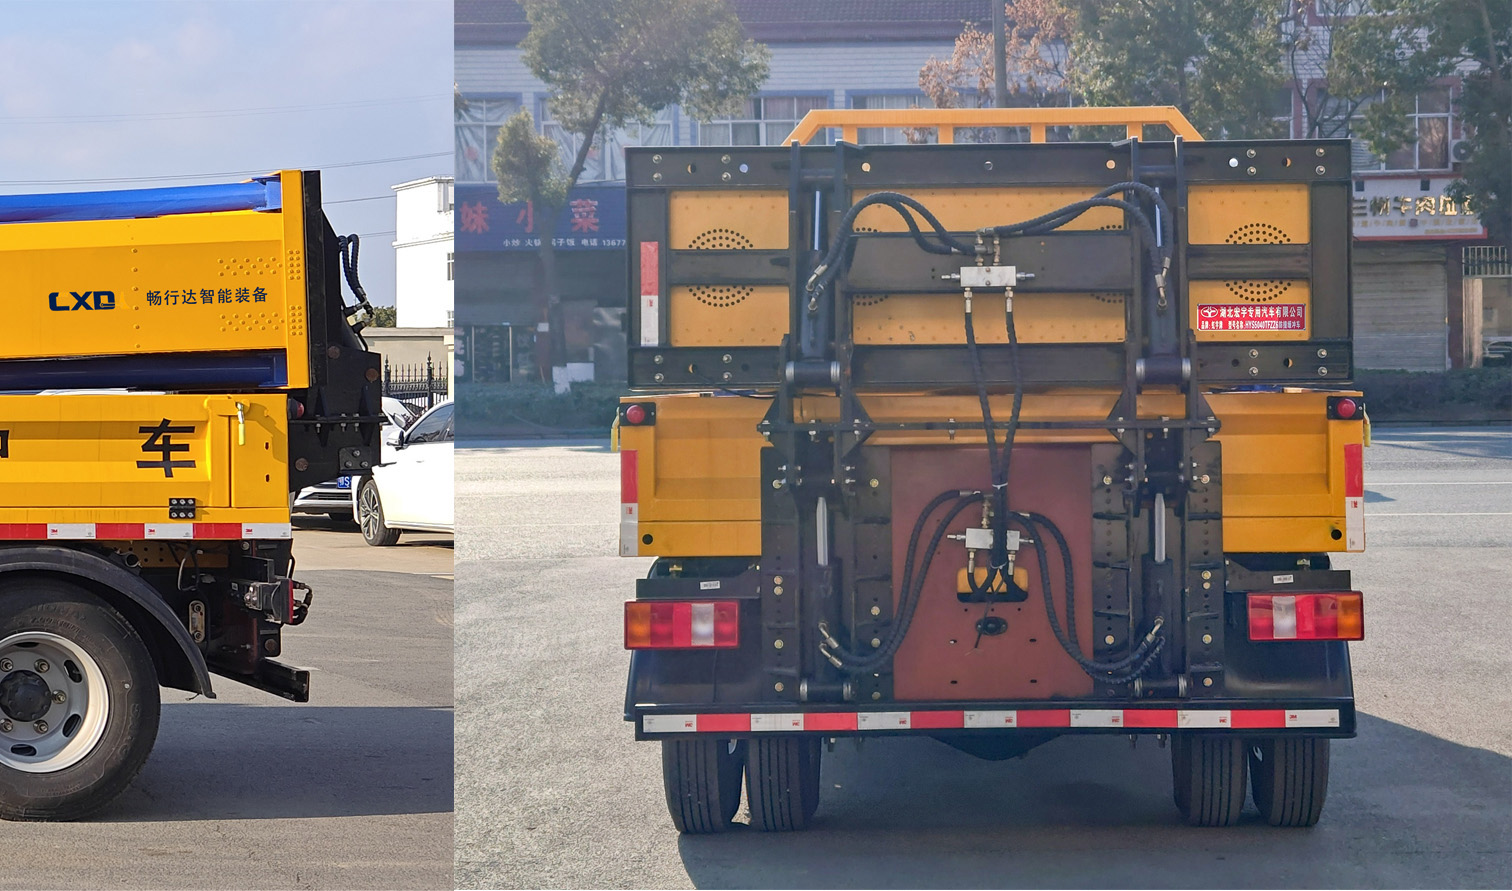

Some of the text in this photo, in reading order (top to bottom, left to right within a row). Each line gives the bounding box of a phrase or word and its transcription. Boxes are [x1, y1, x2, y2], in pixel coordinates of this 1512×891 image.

[146, 286, 269, 307] 畅行达智能装备
[1219, 305, 1304, 318] 湖北宏宇专用汽车有限公司
